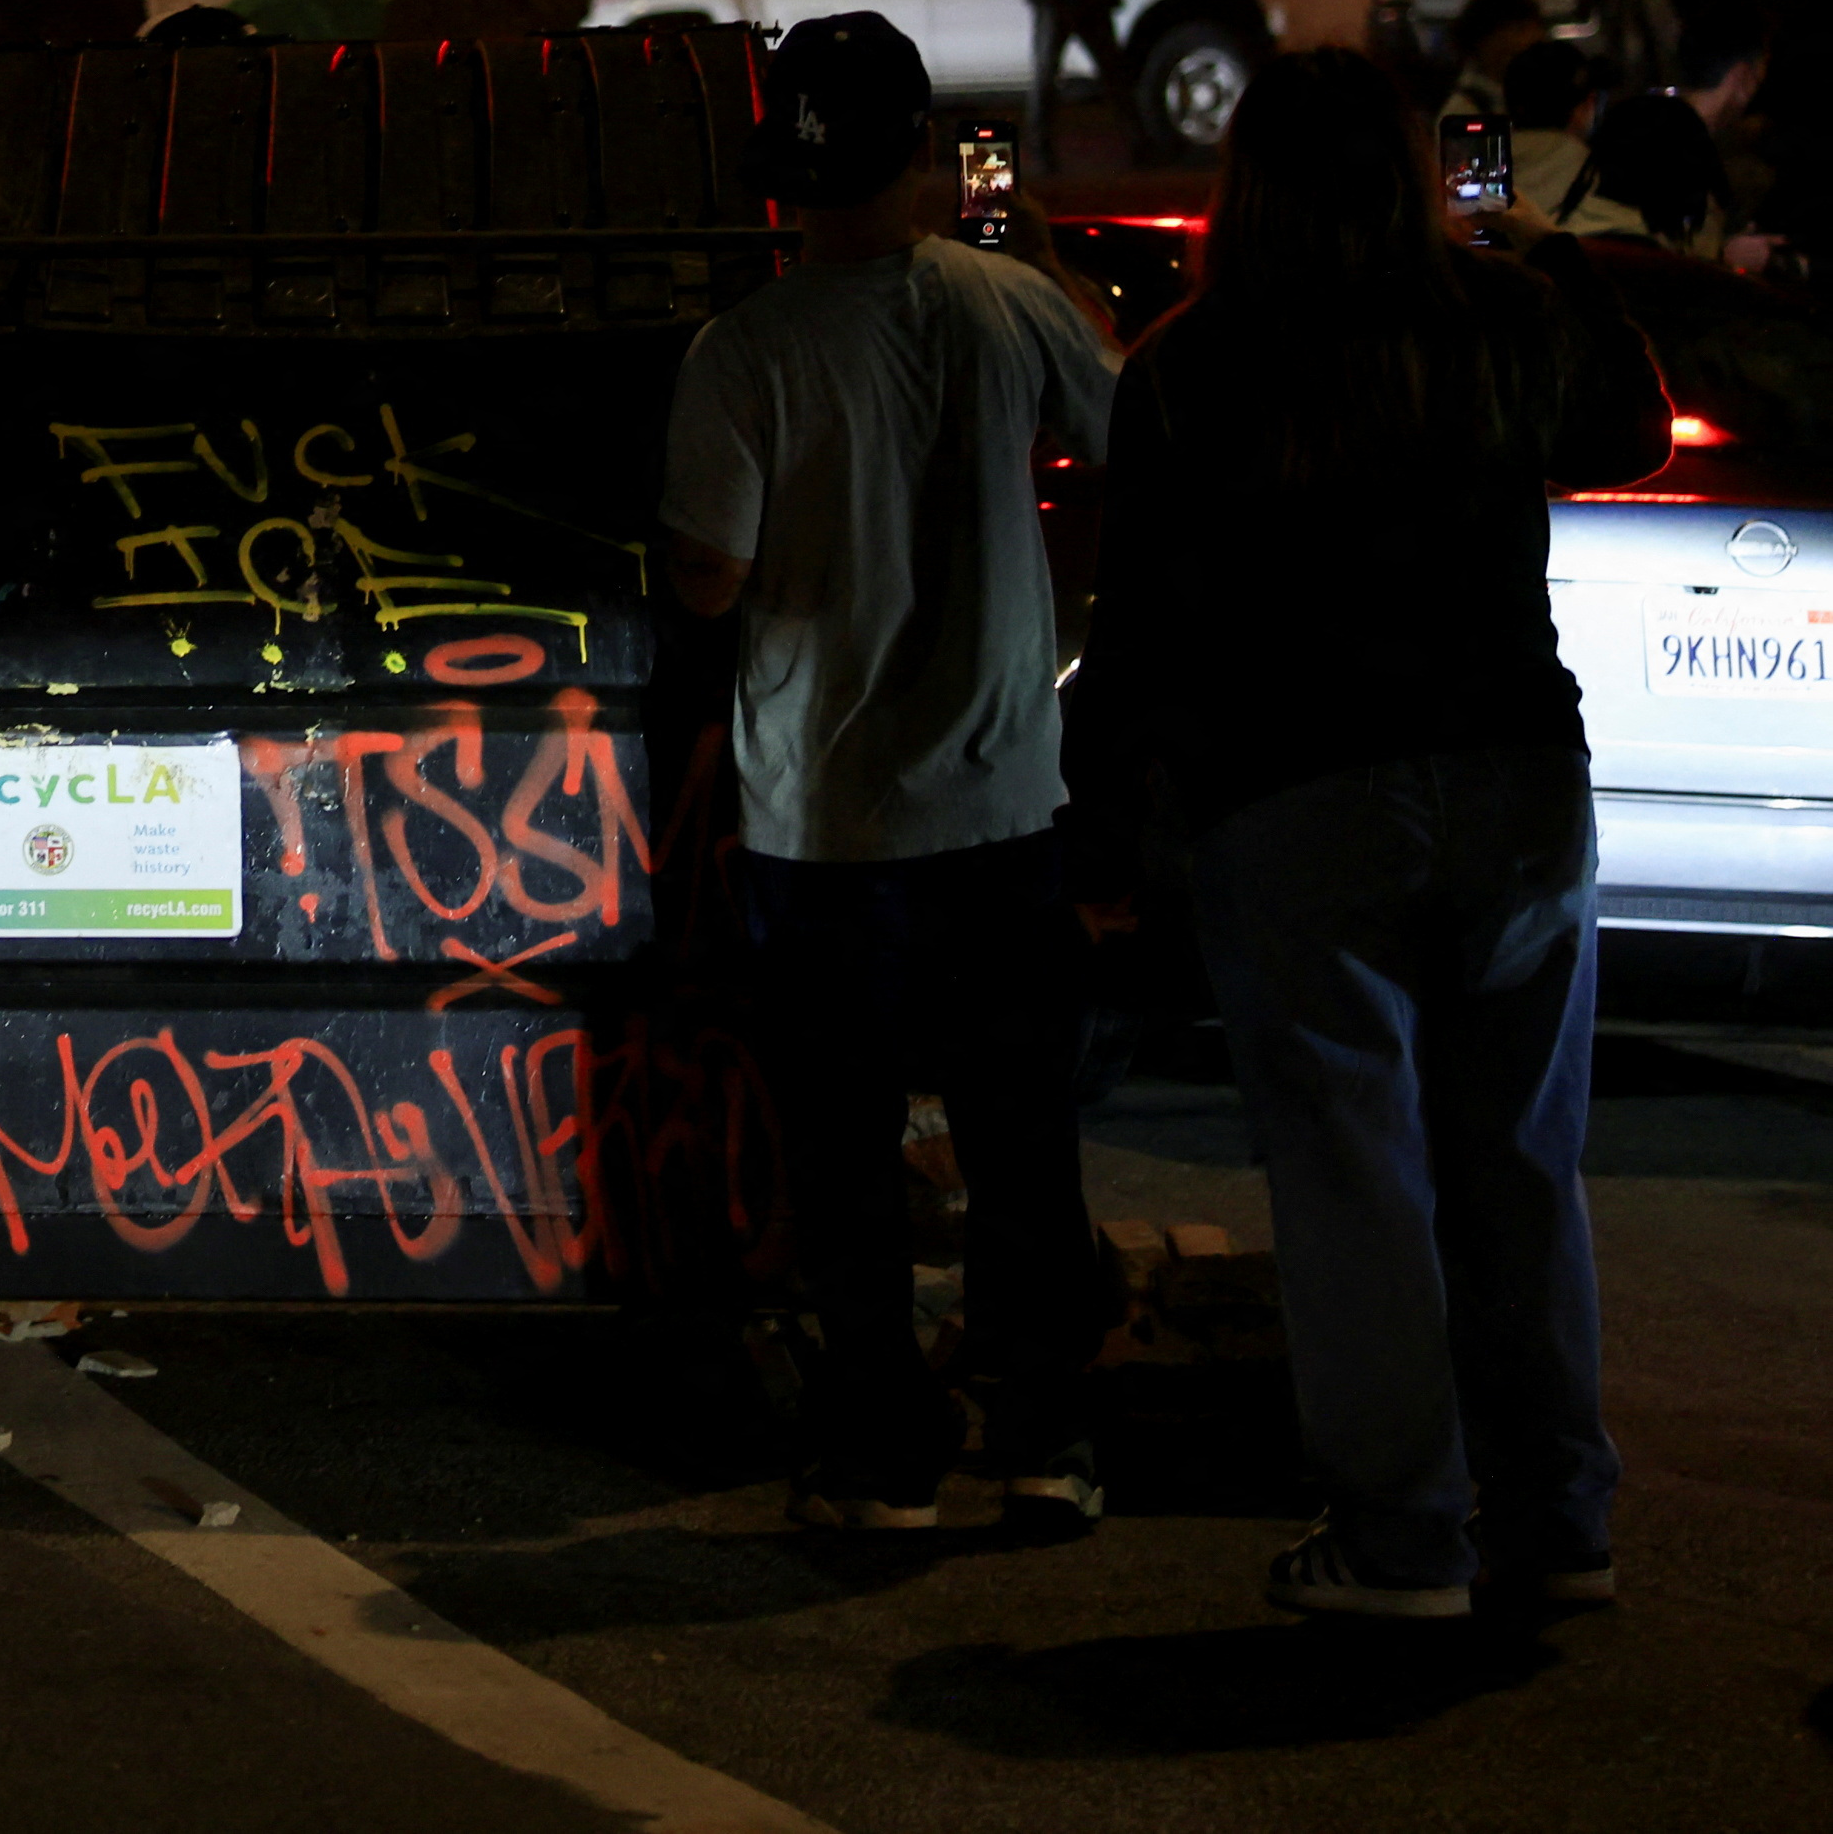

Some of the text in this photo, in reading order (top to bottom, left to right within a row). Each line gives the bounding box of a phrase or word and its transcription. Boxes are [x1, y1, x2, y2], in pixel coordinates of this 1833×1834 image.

[793, 91, 828, 146] LA
[47, 403, 649, 551] FUCK
[91, 513, 589, 634] ICE
[1662, 633, 1833, 682] 9KHN961
[133, 823, 177, 838] Make
[133, 843, 181, 856] waste
[133, 860, 191, 876] history
[18, 900, 47, 917] 311
